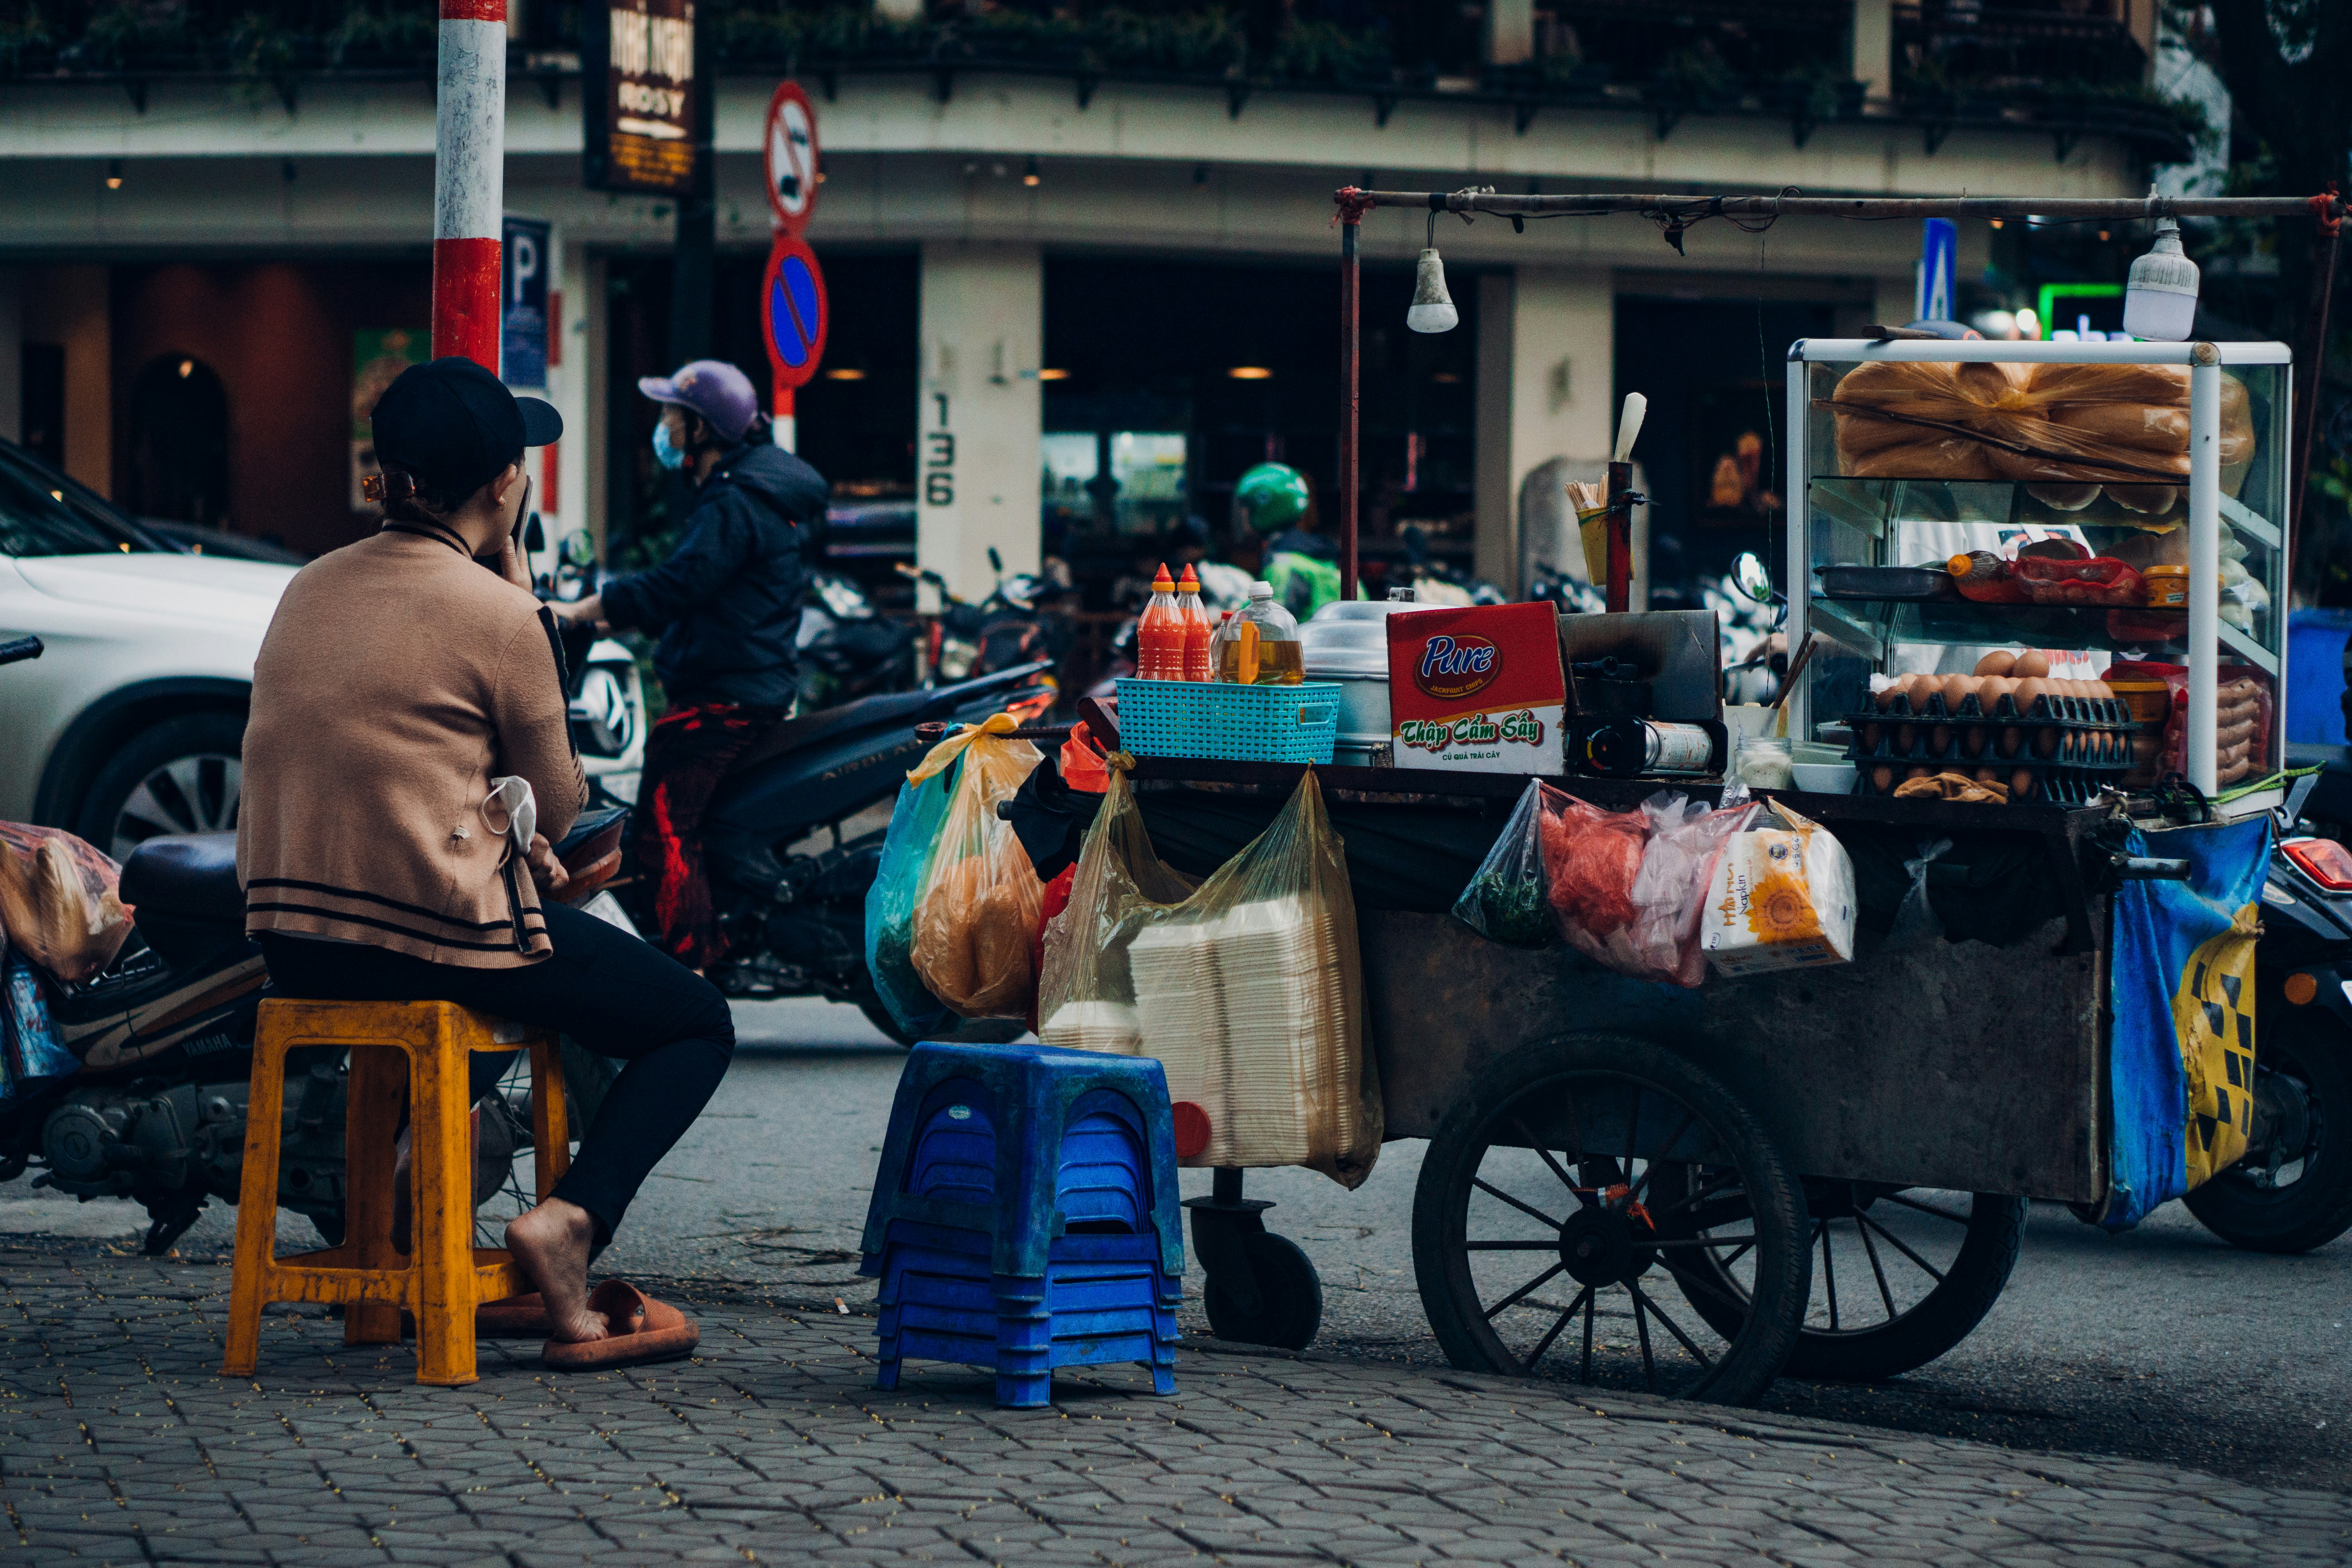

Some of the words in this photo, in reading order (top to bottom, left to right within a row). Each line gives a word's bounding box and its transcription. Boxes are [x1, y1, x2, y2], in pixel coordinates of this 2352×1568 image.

[512, 236, 537, 303] P
[926, 392, 955, 507] 136
[1422, 636, 1495, 677] Pure
[1430, 685, 1464, 694] JACKFRUIT
[1465, 678, 1483, 690] CHIPS
[1399, 720, 1448, 749] Thập
[1452, 713, 1496, 741] Cẩm
[1499, 710, 1539, 742] Sấy
[1453, 751, 1468, 760] QUẢ
[1470, 751, 1484, 759] TRÁI
[1736, 875, 1750, 915] Napkin
[181, 1033, 232, 1057] YAMAHA
